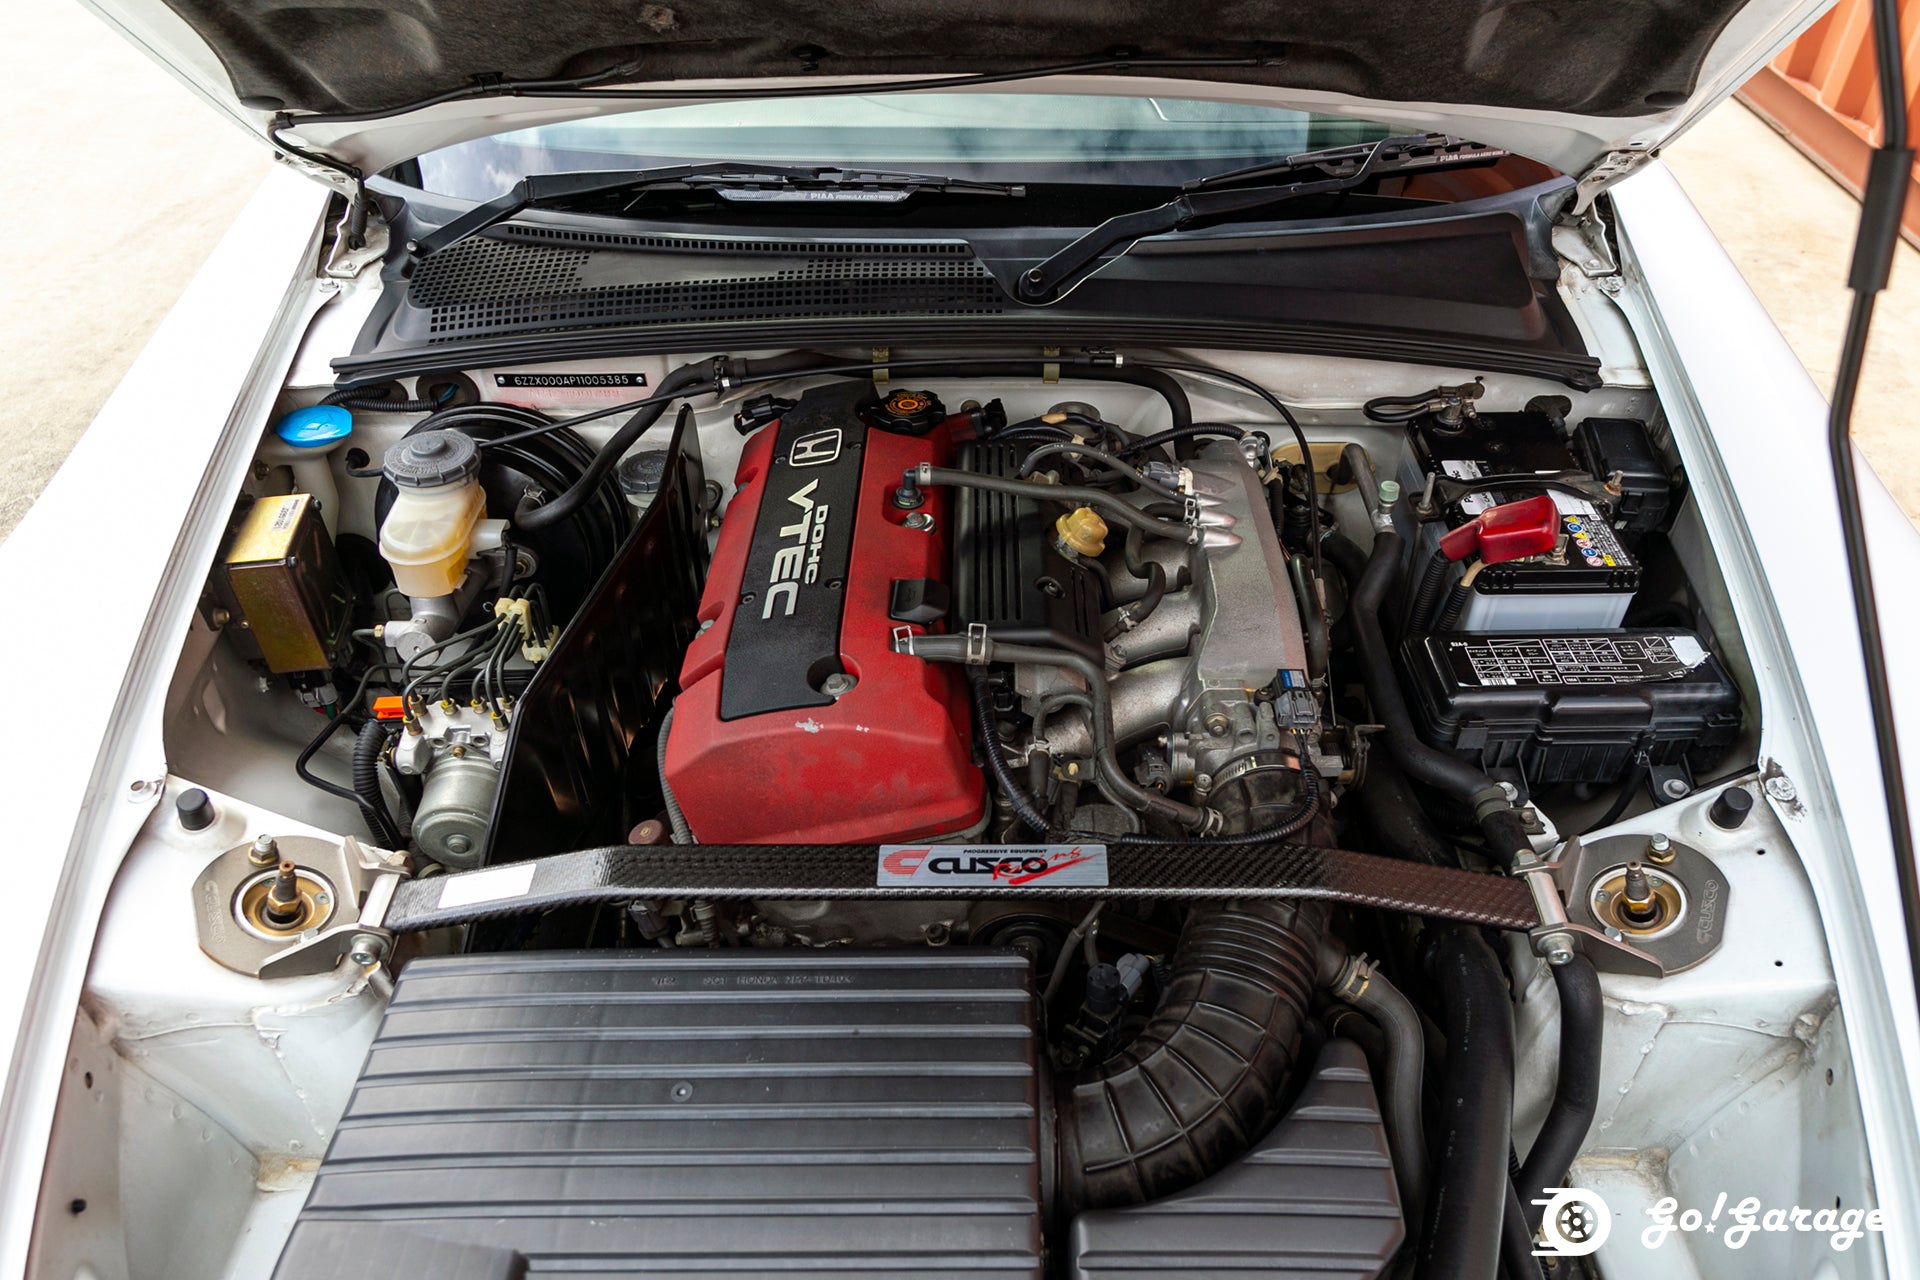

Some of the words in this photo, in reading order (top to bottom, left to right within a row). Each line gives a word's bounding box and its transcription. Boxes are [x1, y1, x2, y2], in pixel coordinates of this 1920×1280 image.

[1440, 153, 1459, 162] PIAA
[810, 192, 835, 200] PIAA
[762, 478, 819, 620] VTEC
[804, 504, 829, 585] DOHC
[928, 857, 1048, 875] CUSCO
[1698, 879, 1719, 933] CUSCO
